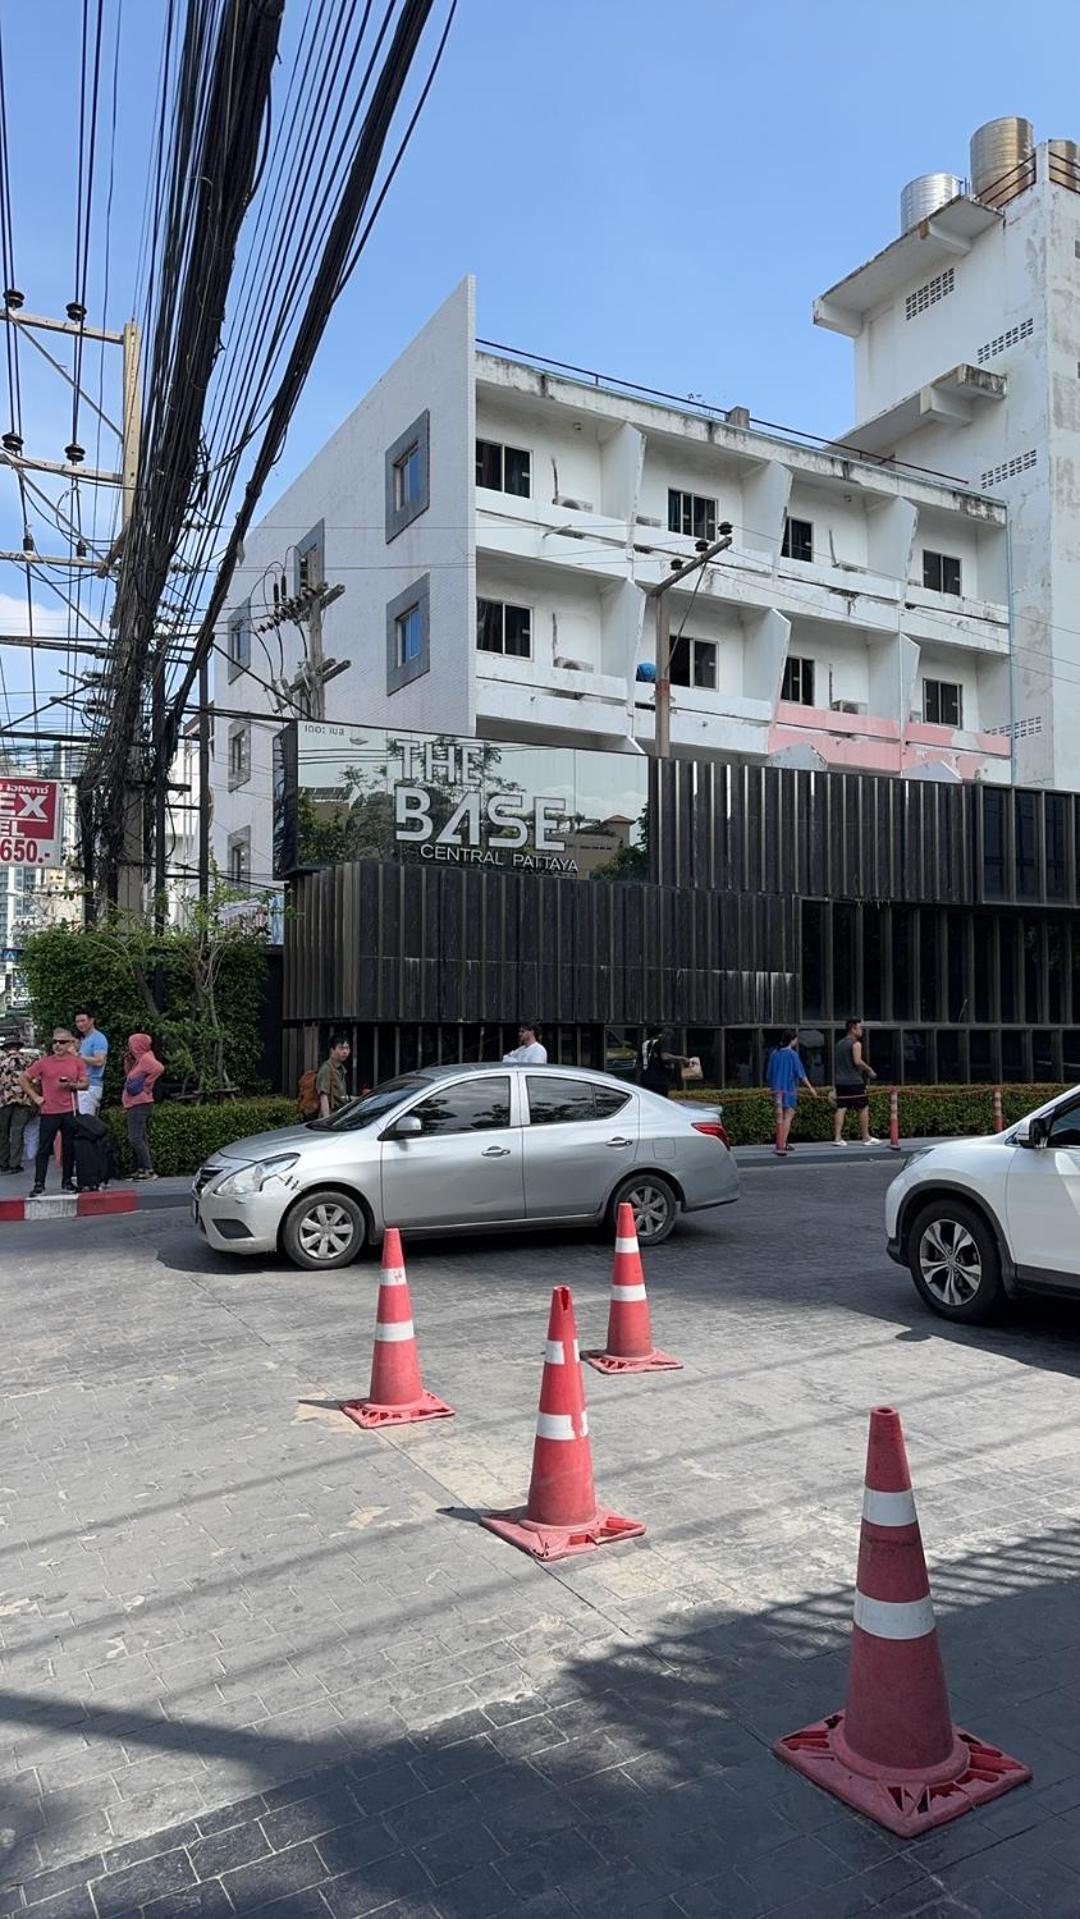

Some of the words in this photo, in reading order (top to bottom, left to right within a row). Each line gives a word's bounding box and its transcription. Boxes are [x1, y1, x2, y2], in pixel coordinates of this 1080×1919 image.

[395, 739, 481, 786] THE
[396, 786, 566, 851] BASE
[420, 844, 504, 866] CENTRAL
[512, 853, 579, 872] PATTAYA
